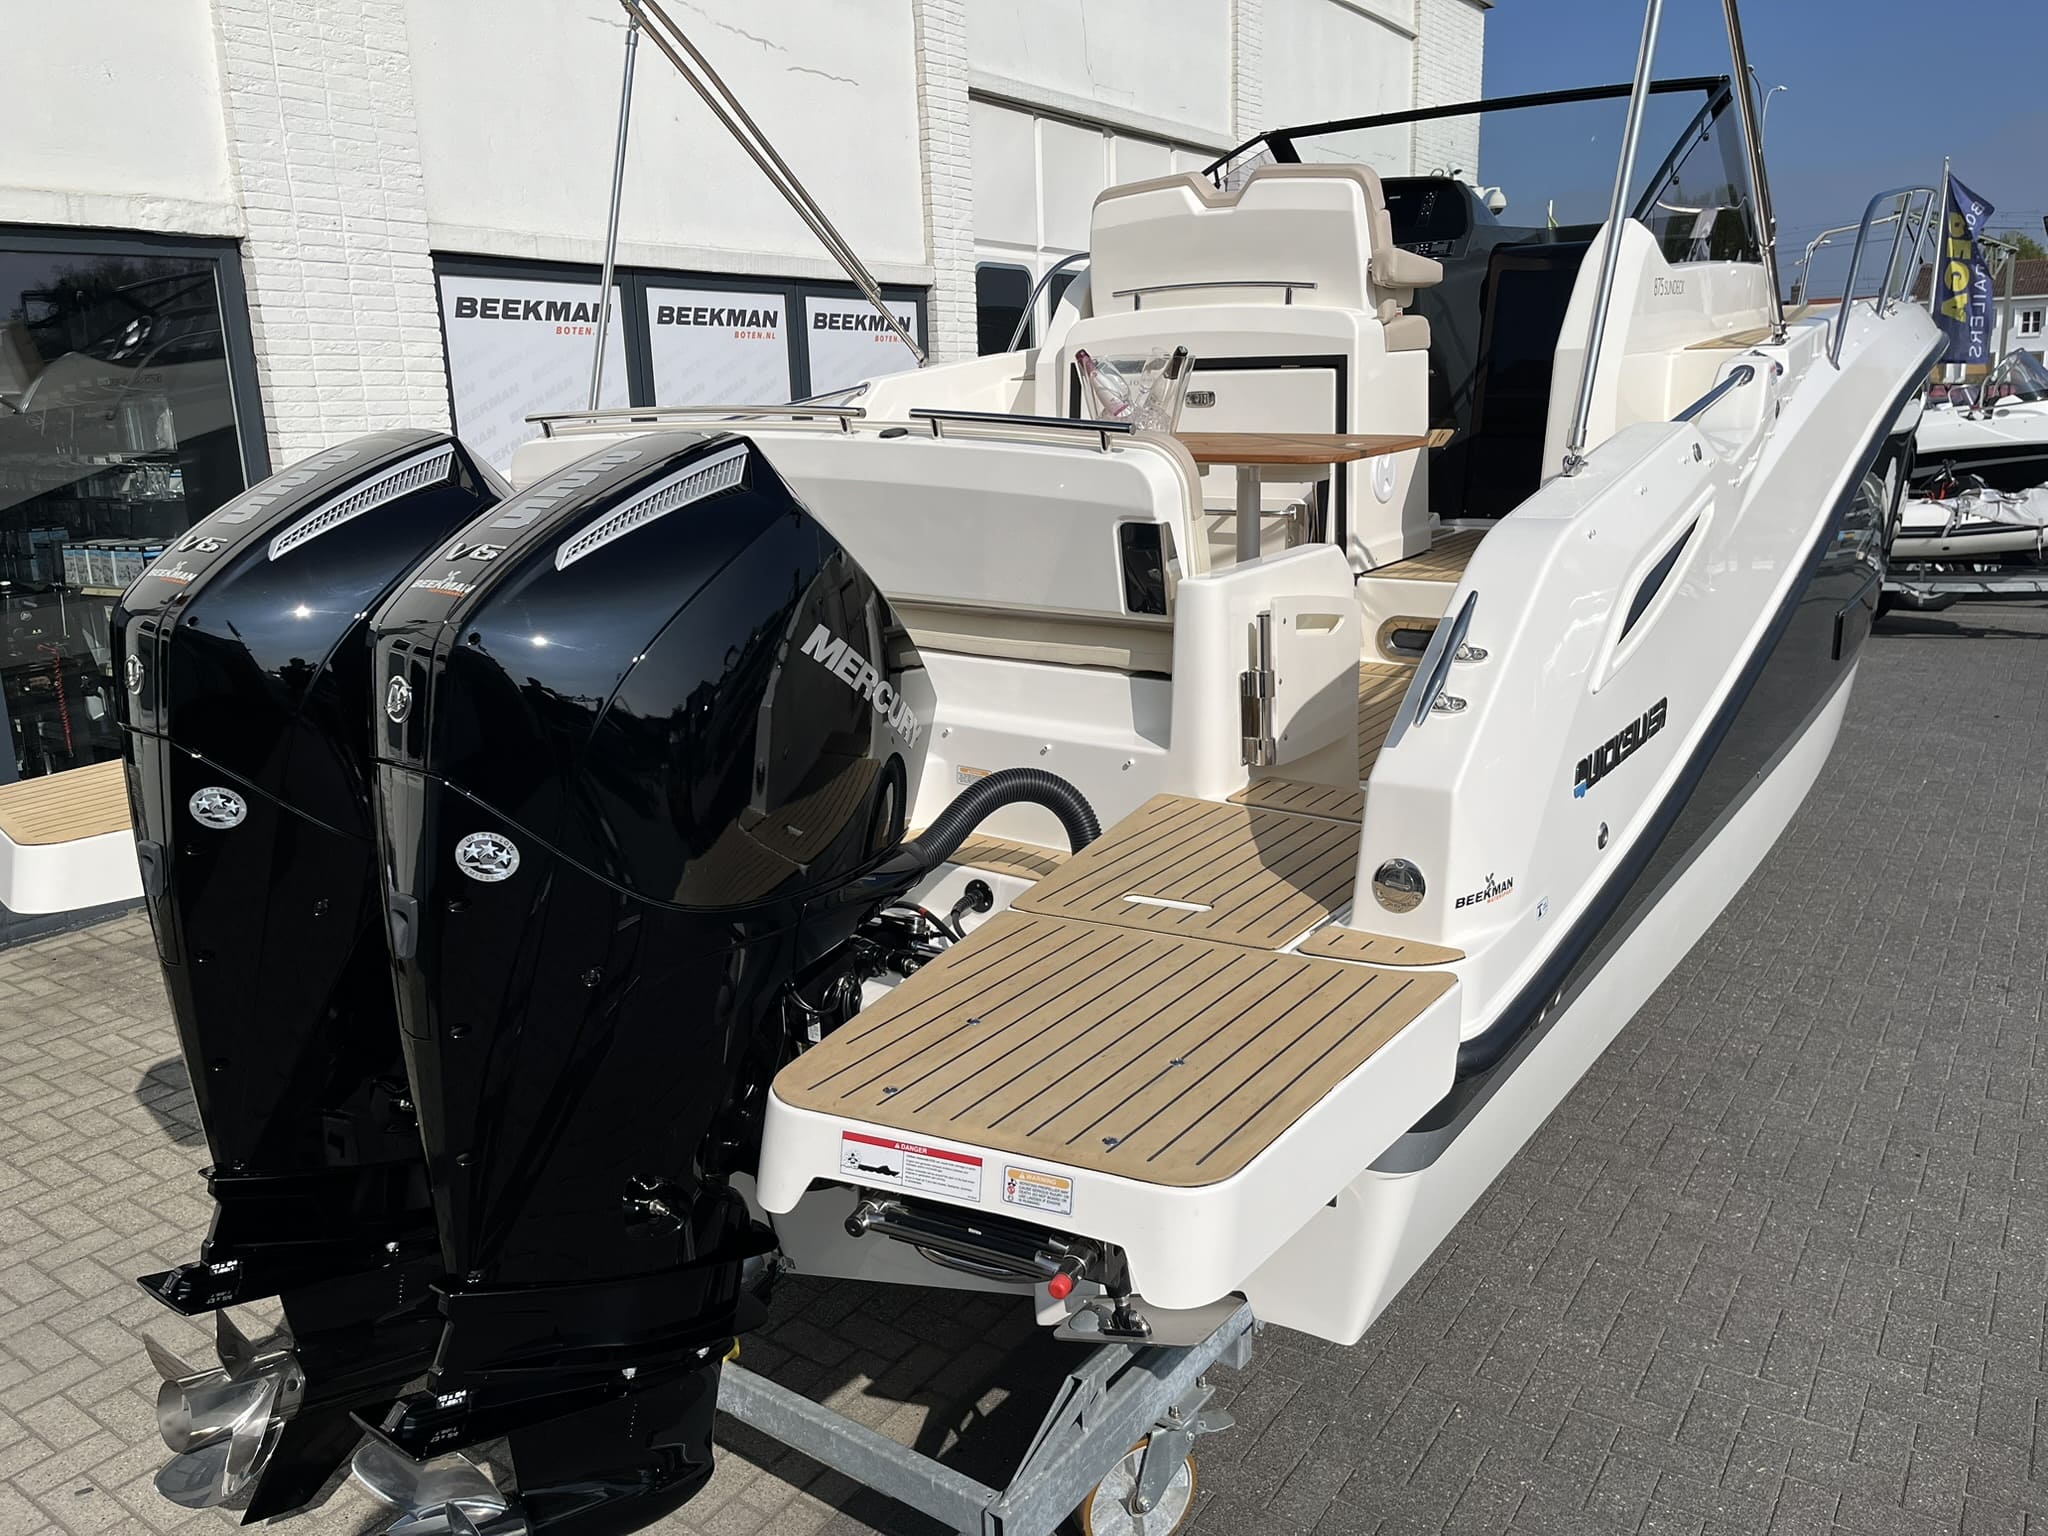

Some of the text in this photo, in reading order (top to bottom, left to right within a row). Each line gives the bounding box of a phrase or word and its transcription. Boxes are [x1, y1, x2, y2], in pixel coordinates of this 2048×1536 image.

[657, 306, 778, 328] BEEKMAN
[556, 326, 608, 336] BOTEN.
[734, 331, 776, 339] BOTEN.NL
[874, 335, 904, 343] BOTEN.
[411, 578, 476, 593] BEEKMAN
[800, 623, 922, 749] MERCURY
[1455, 877, 1513, 909] BEEKMAN
[901, 1144, 928, 1155] DANGER
[1026, 1174, 1057, 1186] WARNING
